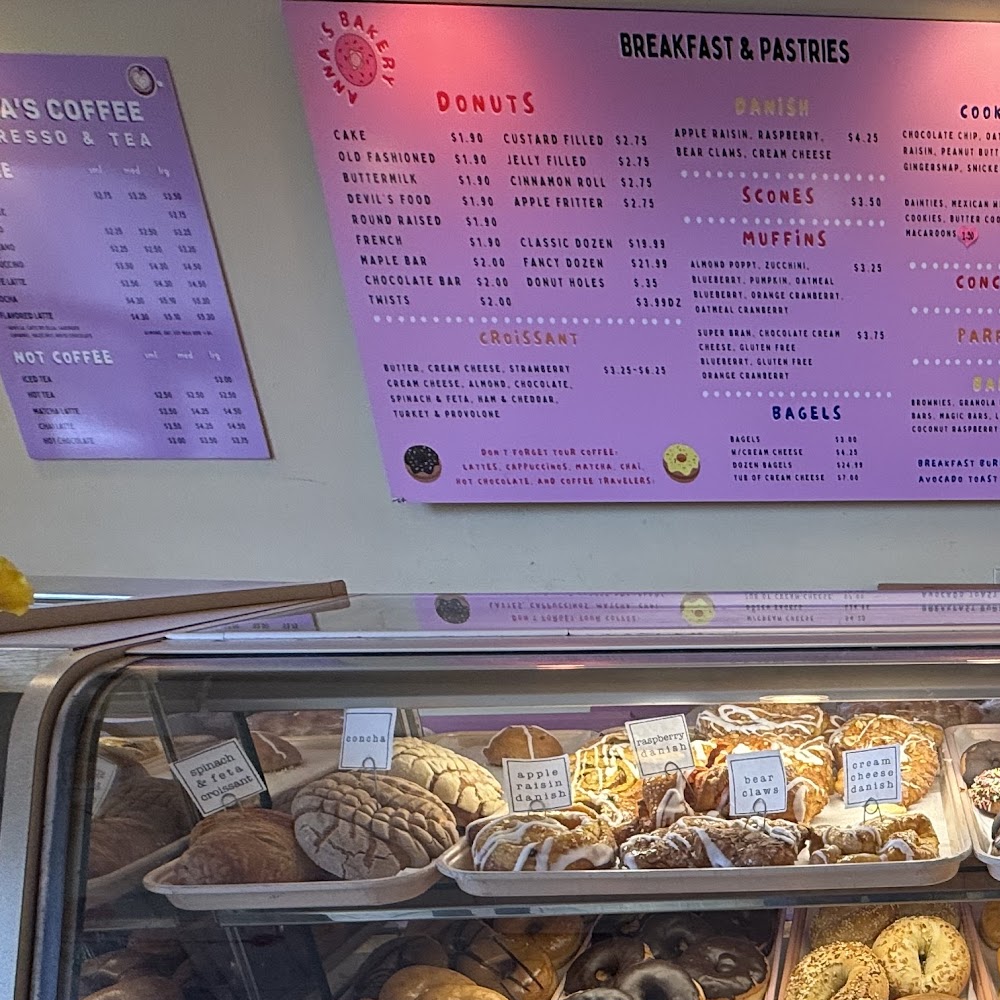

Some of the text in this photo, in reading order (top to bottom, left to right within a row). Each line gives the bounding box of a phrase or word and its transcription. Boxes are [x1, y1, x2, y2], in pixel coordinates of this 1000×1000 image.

[338, 10, 396, 88] BAKERY
[620, 32, 850, 64] BREAKFAST & PASTRIES
[436, 90, 535, 114] DONUTS
[45, 99, 144, 122] COFFEE
[82, 131, 95, 146] &
[108, 132, 152, 147] TEA
[334, 130, 484, 143] CAKE $1.90
[504, 133, 647, 146] CUSTARD FILLED $2.75
[674, 128, 879, 144] APPLE $4.25
[902, 130, 954, 140] CHOCOLATE
[338, 151, 436, 164] OLD FASHIONED
[508, 154, 586, 167] JELLY FILLED
[342, 172, 417, 184] BUTTERMILK
[510, 176, 606, 188] CINNAMON ROLL
[346, 194, 432, 206] DEVIL'S FOOD
[742, 186, 815, 205] SCONES
[514, 196, 604, 208] APPLE FRITTER
[851, 197, 882, 208] $3.50
[352, 214, 442, 226] ROUND RAISED
[356, 234, 402, 246] FRENCH
[520, 237, 666, 249] CLASSIC DOZEN $19.99
[360, 255, 506, 268] MAPLE BAR $2.00
[524, 257, 668, 269] FANCY DOZEN $21.99
[365, 275, 462, 287] CHOCOLATE BAR
[527, 277, 605, 288] DONUT HOLES
[368, 295, 410, 305] TWISTS
[636, 297, 682, 308] $3.99DZ
[14, 350, 114, 365] NOT COFFEE
[603, 366, 667, 376] $3.25-$6.25
[772, 405, 841, 420] BAGELS
[917, 458, 975, 468] BREAKFAST
[346, 734, 386, 743] concha
[637, 732, 685, 748] raspberry
[641, 743, 688, 758] danish
[190, 754, 236, 778] spinach
[852, 758, 892, 769] cream
[196, 765, 244, 789] & feta
[517, 769, 559, 783] apple
[744, 774, 774, 784] bear
[851, 770, 894, 782] cheese
[200, 775, 253, 802] croissant
[516, 780, 563, 792] raisin
[742, 787, 779, 797] claws
[851, 780, 894, 794] danish
[515, 791, 566, 803] danish
